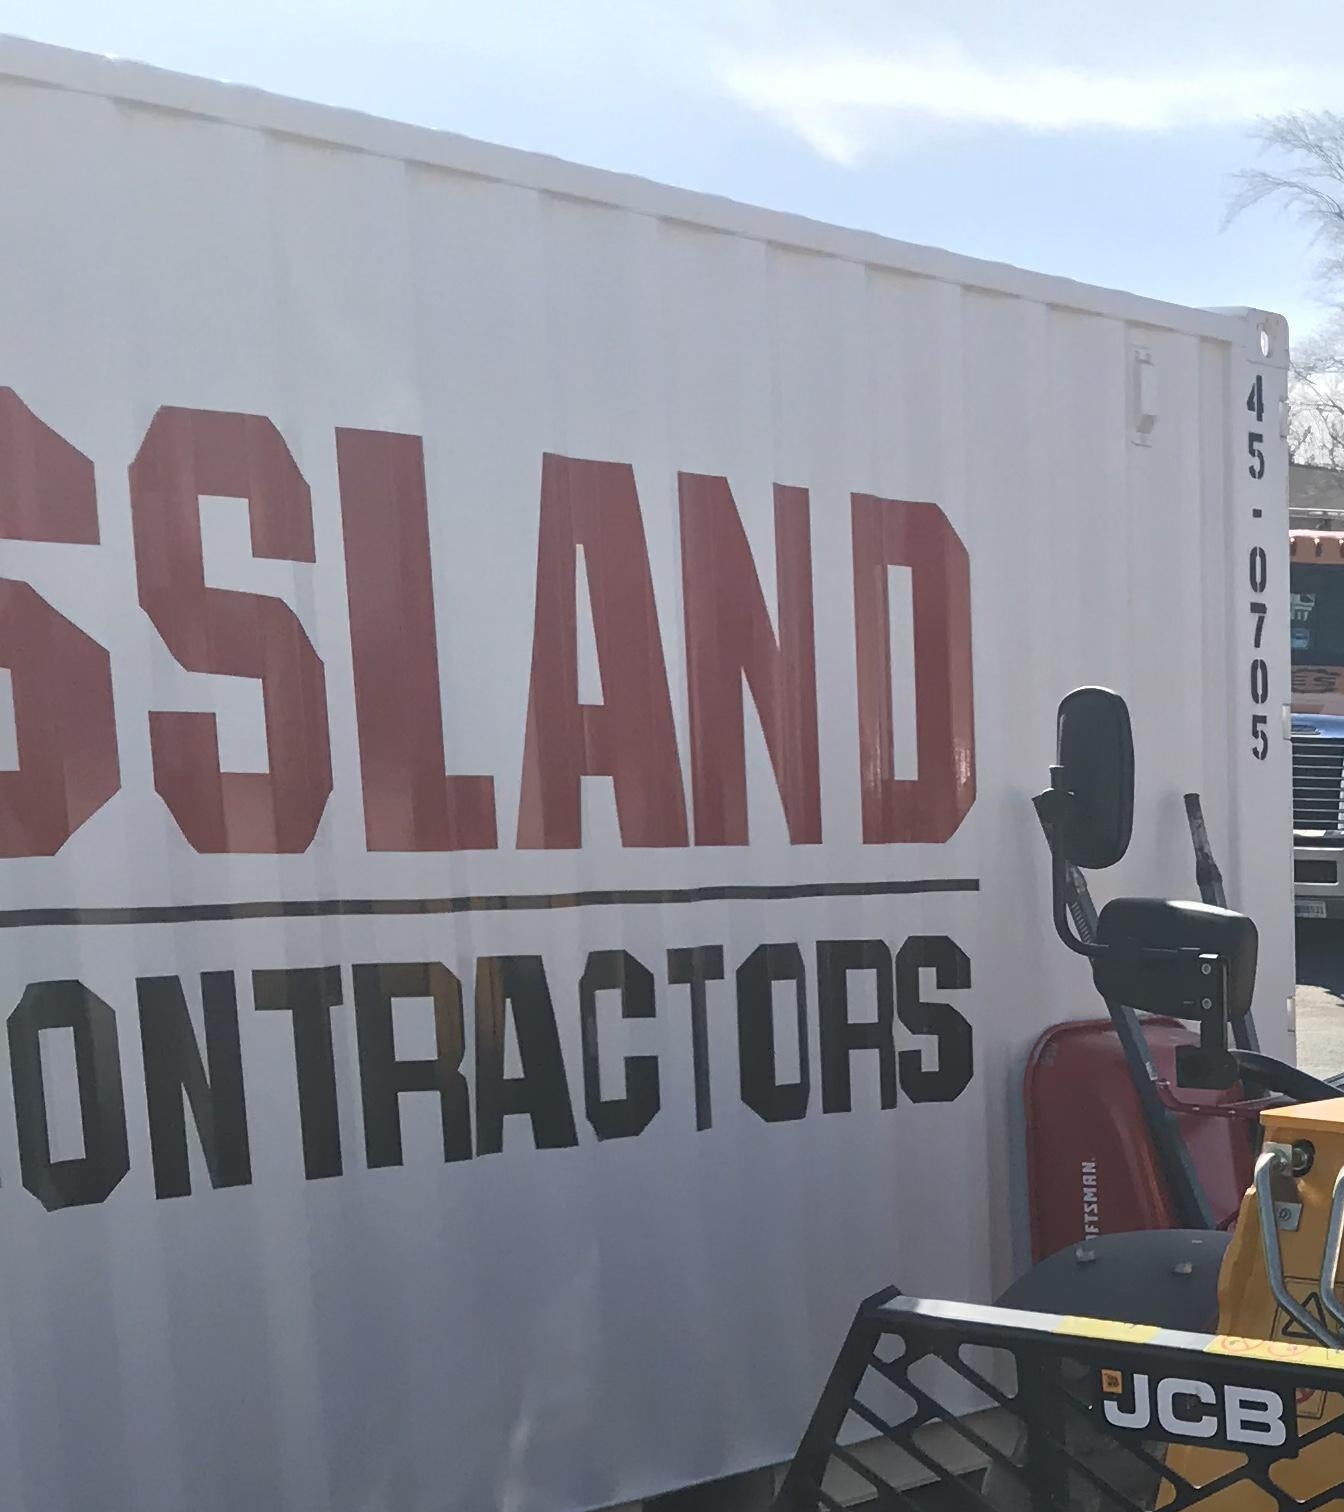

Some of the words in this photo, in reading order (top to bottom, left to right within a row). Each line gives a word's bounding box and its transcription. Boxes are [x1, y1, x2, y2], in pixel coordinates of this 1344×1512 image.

[1246, 374, 1269, 761] 45-0705
[0, 935, 974, 1212] ONTRACTORS
[1103, 1373, 1287, 1447] JCB
